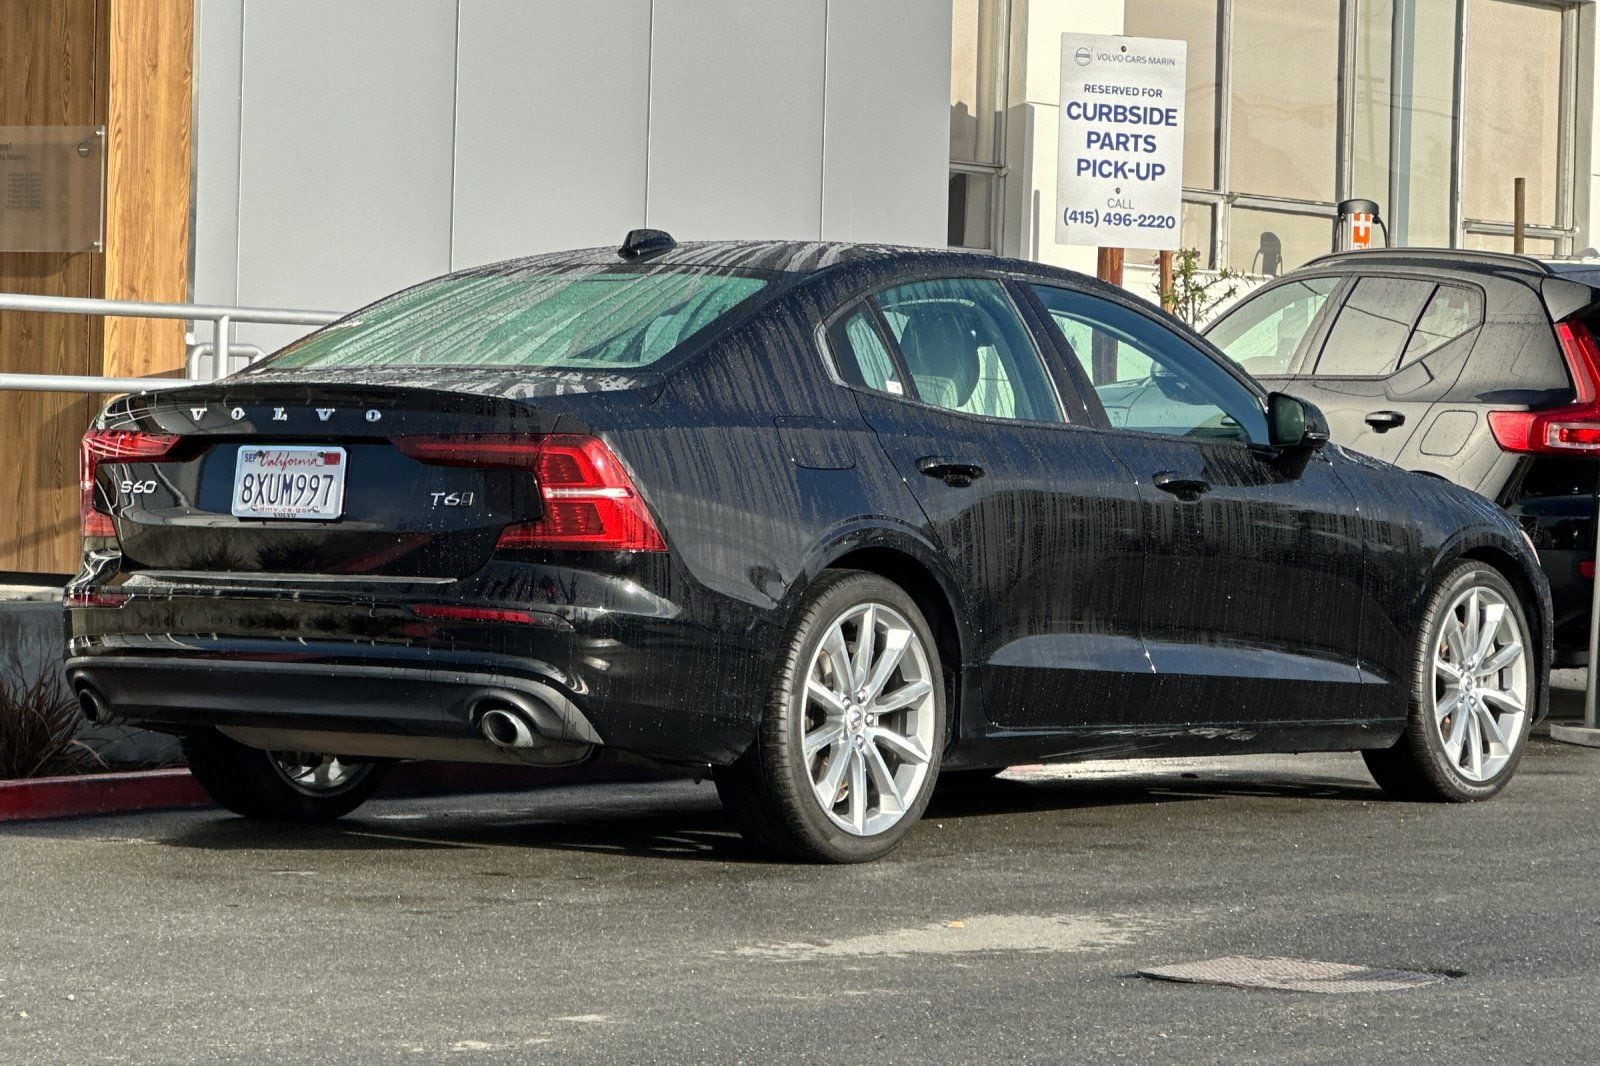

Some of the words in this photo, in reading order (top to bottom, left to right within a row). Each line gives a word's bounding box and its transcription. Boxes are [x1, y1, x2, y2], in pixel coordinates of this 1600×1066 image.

[1096, 53, 1124, 62] VOLVO
[1125, 55, 1147, 64] CARS
[1148, 57, 1175, 66] MARIN
[1083, 83, 1140, 97] RESERVED
[1142, 88, 1163, 98] FOR
[1066, 101, 1178, 127] CURBSIDE
[1086, 130, 1157, 153] PARTS
[1076, 158, 1165, 181] PICK-UP
[1107, 198, 1134, 209] CALL
[1063, 207, 1099, 227] (415)
[1103, 212, 1176, 229] 496-2220
[190, 406, 382, 422] VOLVO
[260, 450, 324, 471] California
[121, 480, 157, 493] S60
[241, 473, 334, 506] 8XUM997
